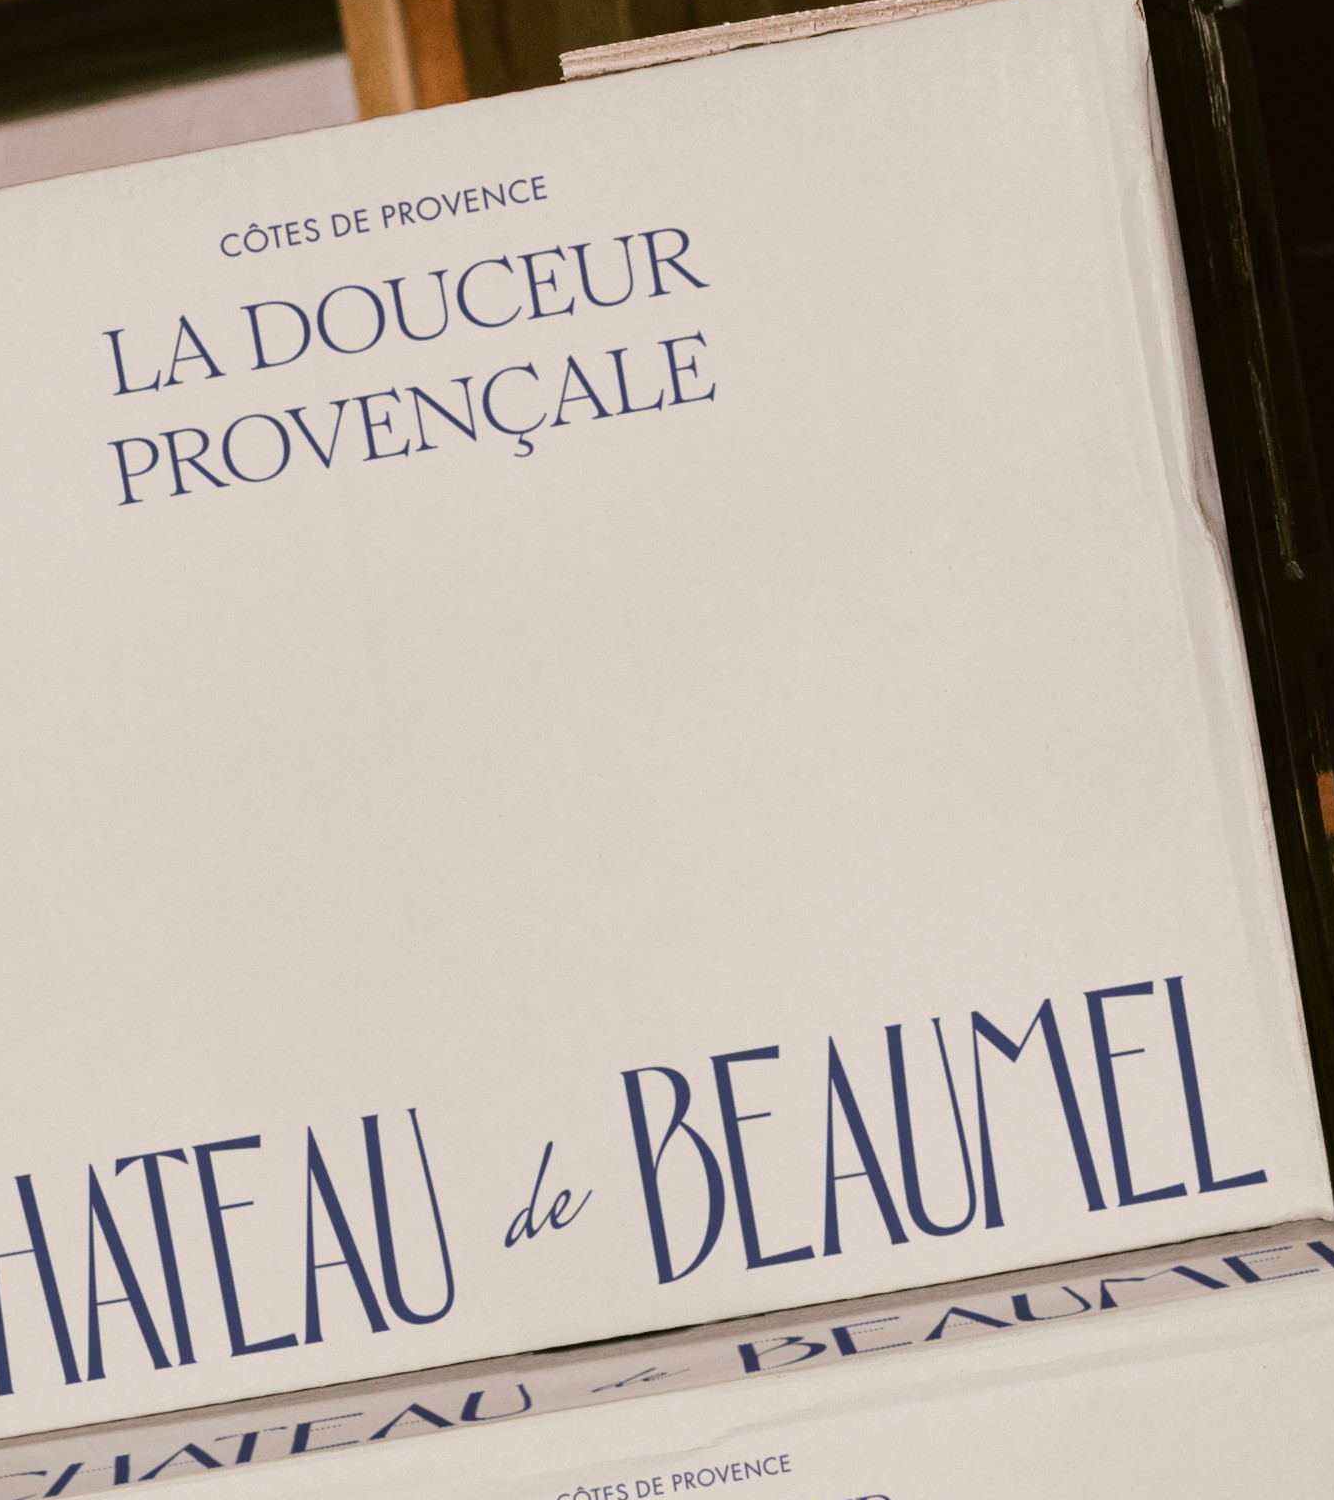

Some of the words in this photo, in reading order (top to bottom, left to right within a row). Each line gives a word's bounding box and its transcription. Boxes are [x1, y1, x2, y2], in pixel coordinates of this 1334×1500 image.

[220, 218, 320, 257] CÔTES
[331, 209, 370, 237] DE
[381, 176, 548, 228] PROVENCE
[103, 315, 226, 396] LA
[241, 228, 709, 370] DOUCEUR
[108, 331, 716, 505] PROVENÇALE
[504, 1141, 588, 1248] de
[620, 976, 1268, 1285] BEAUMEL
[636, 1477, 663, 1498] DE
[672, 1455, 790, 1491] PROVENCE
